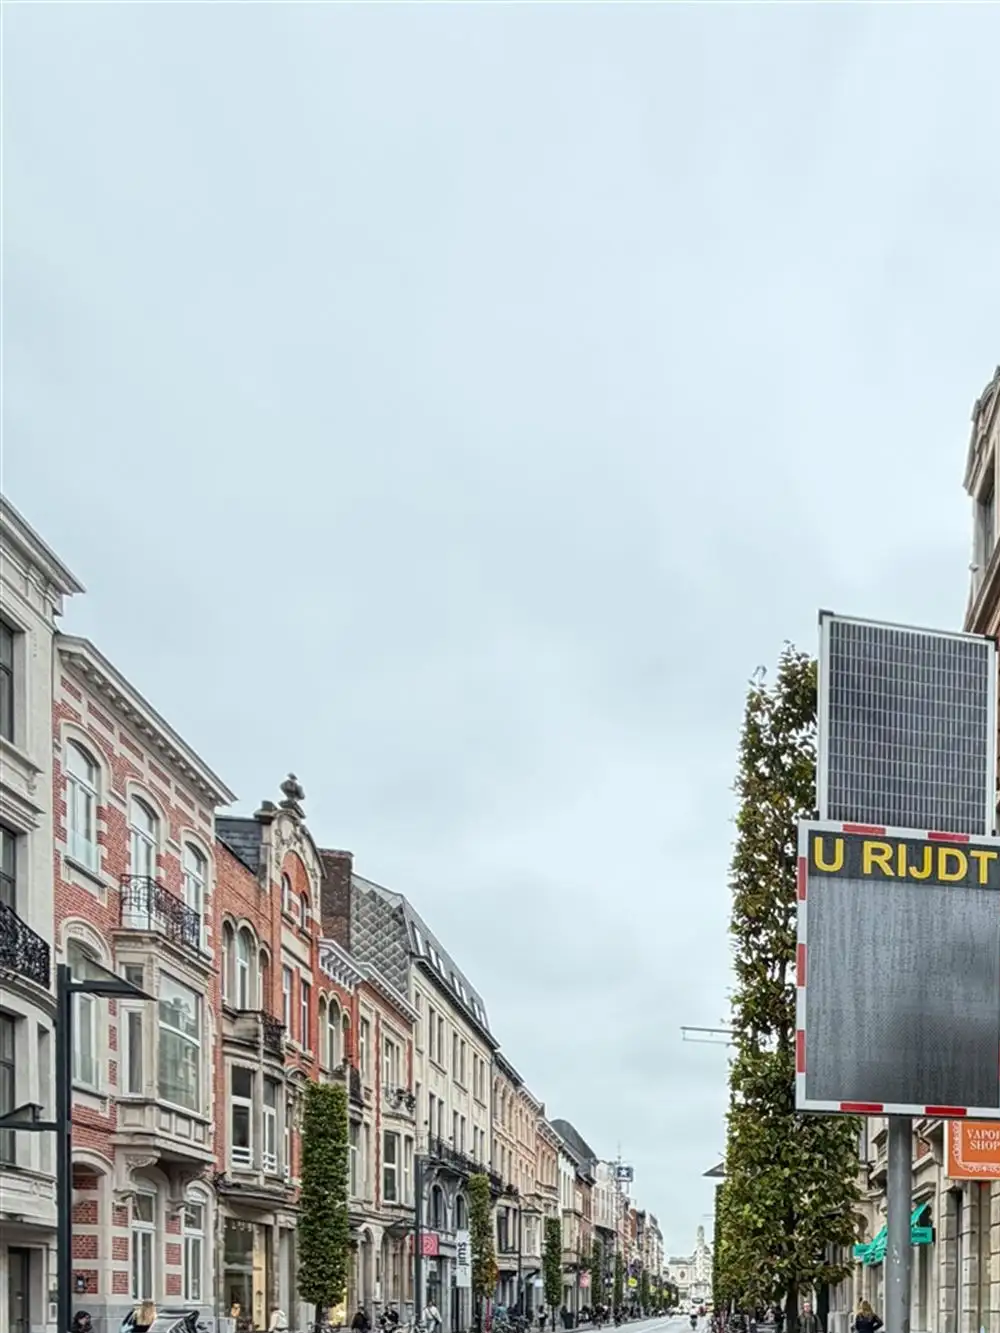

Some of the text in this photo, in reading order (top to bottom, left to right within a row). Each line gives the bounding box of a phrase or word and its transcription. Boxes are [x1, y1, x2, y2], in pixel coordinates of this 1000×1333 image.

[814, 837, 998, 884] U RIJDT
[970, 1140, 1000, 1151] SHOP
